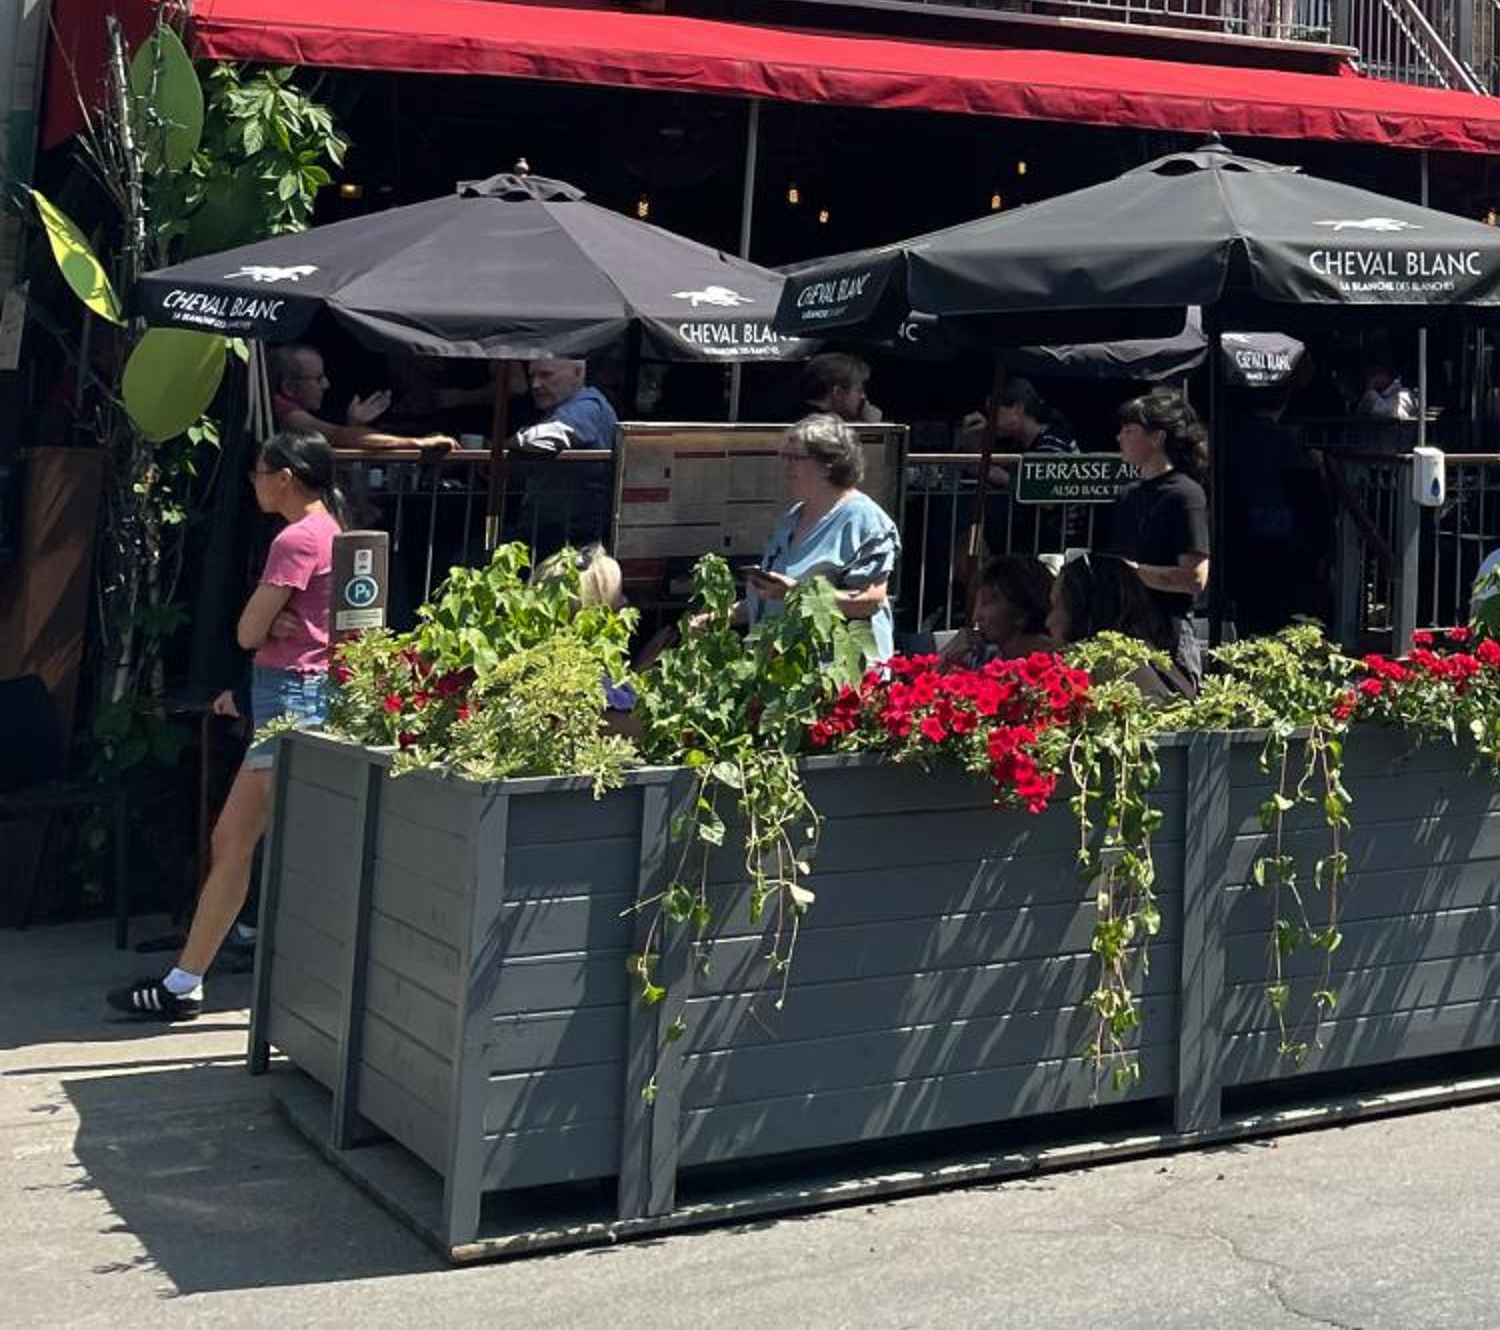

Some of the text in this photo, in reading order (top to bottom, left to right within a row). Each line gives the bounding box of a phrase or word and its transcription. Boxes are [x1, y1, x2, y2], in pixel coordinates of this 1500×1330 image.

[1309, 251, 1482, 276] CHEVAL BLANC
[163, 289, 284, 321] CHEVAL BLANC
[679, 323, 739, 344] CHEVAL
[1024, 462, 1111, 480] TERRASSE
[1051, 485, 1079, 496] ALSO
[1081, 485, 1109, 495] BACK
